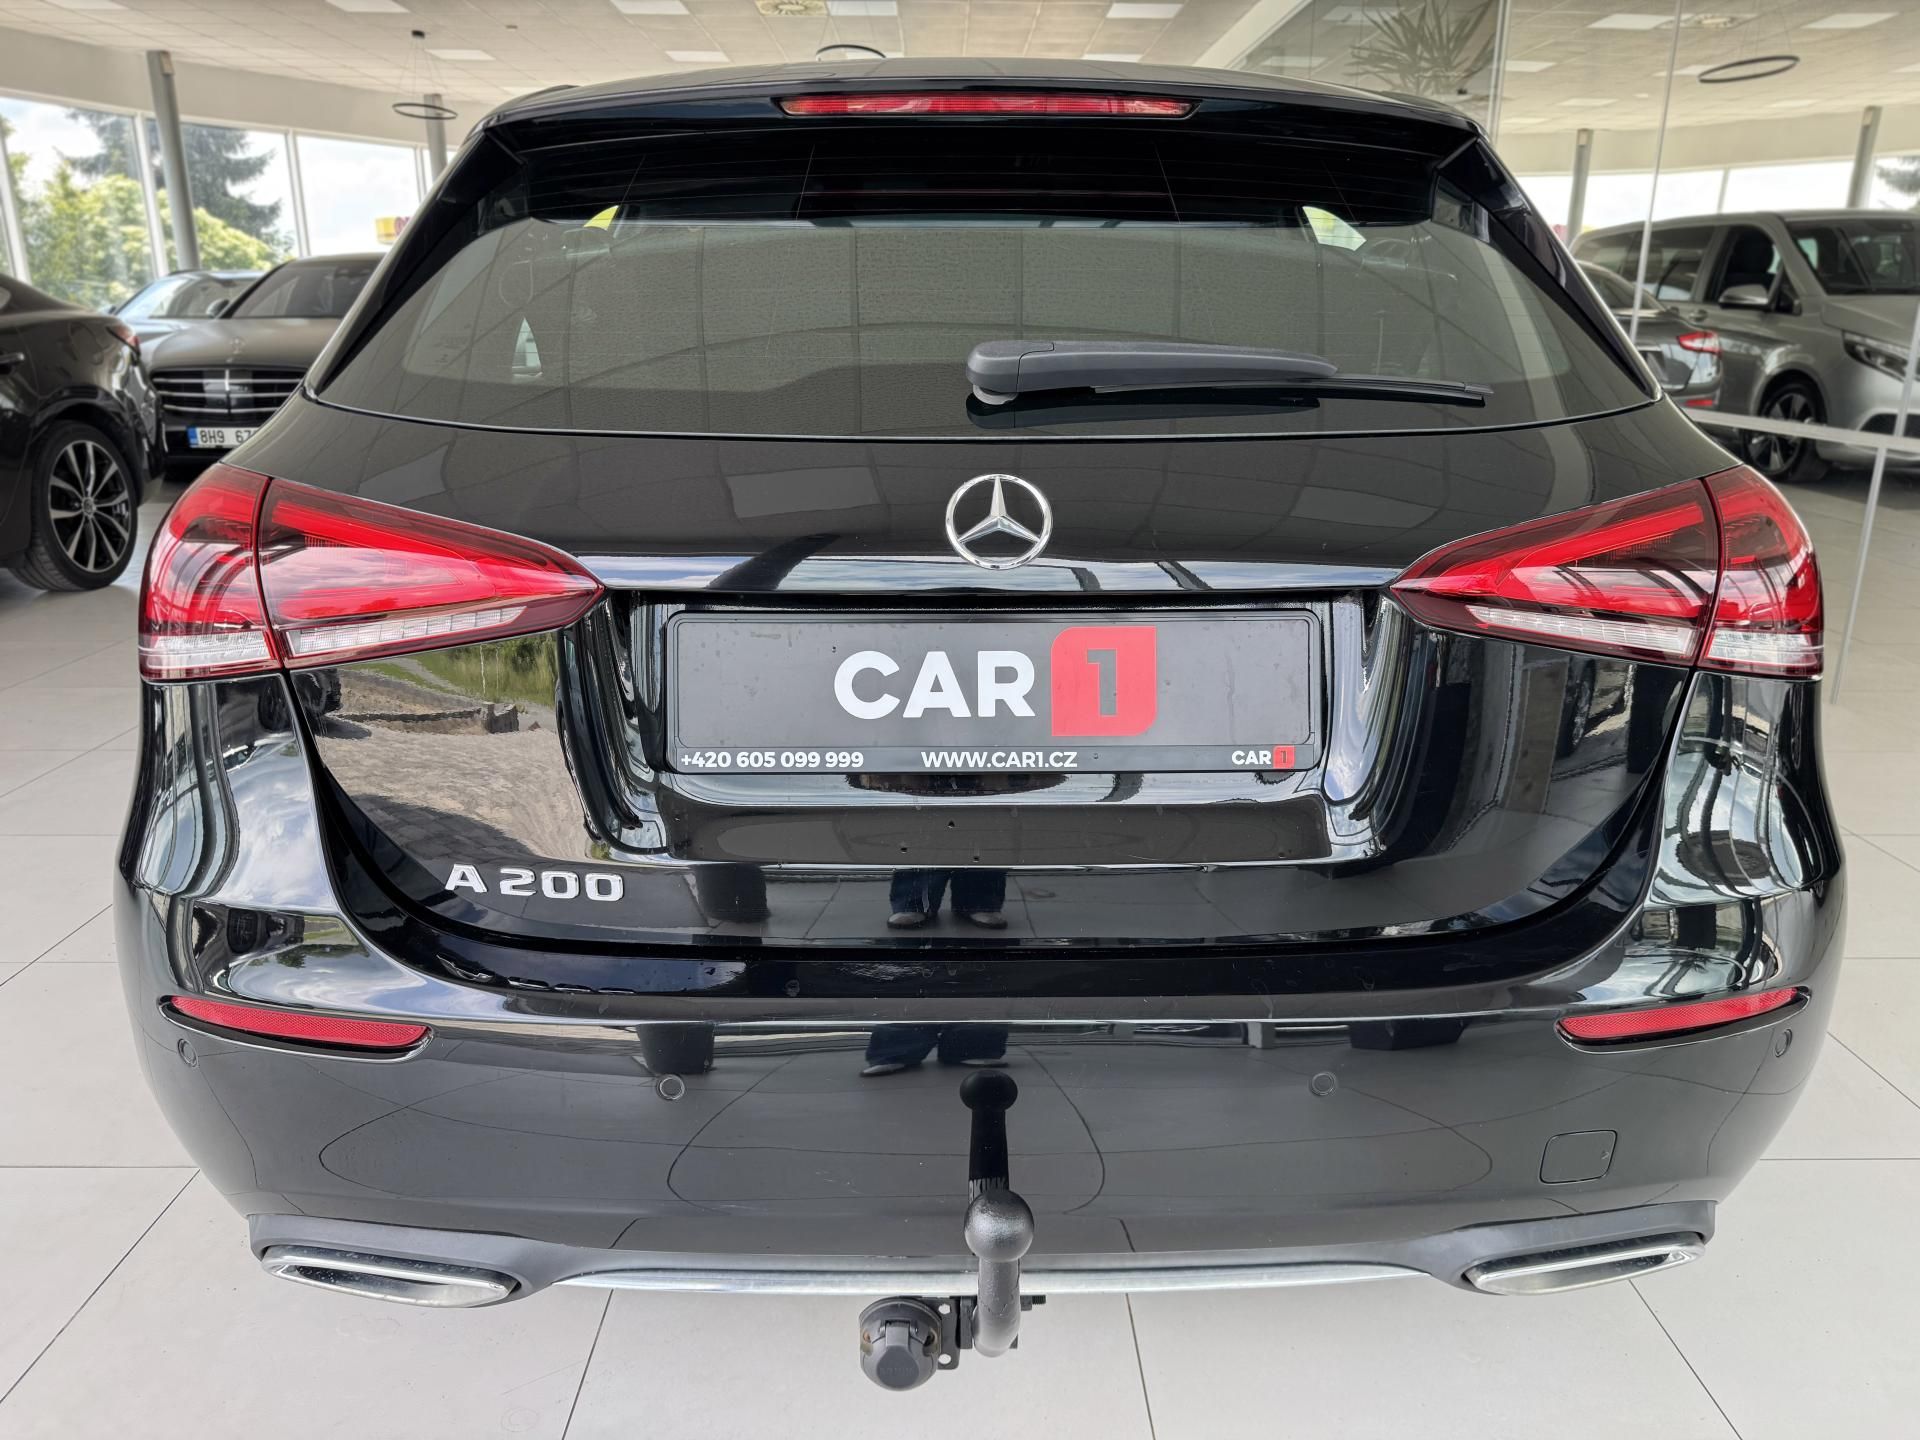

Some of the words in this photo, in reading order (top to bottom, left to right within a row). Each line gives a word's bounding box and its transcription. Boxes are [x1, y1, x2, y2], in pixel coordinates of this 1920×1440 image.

[200, 430, 225, 444] 8H9
[681, 751, 732, 768] +420
[736, 751, 776, 768] 605
[780, 751, 821, 768] 099
[825, 751, 864, 768] 999
[920, 751, 1078, 768] WWW.CAR1.CZ
[444, 864, 488, 893] A
[499, 868, 624, 902] 200
